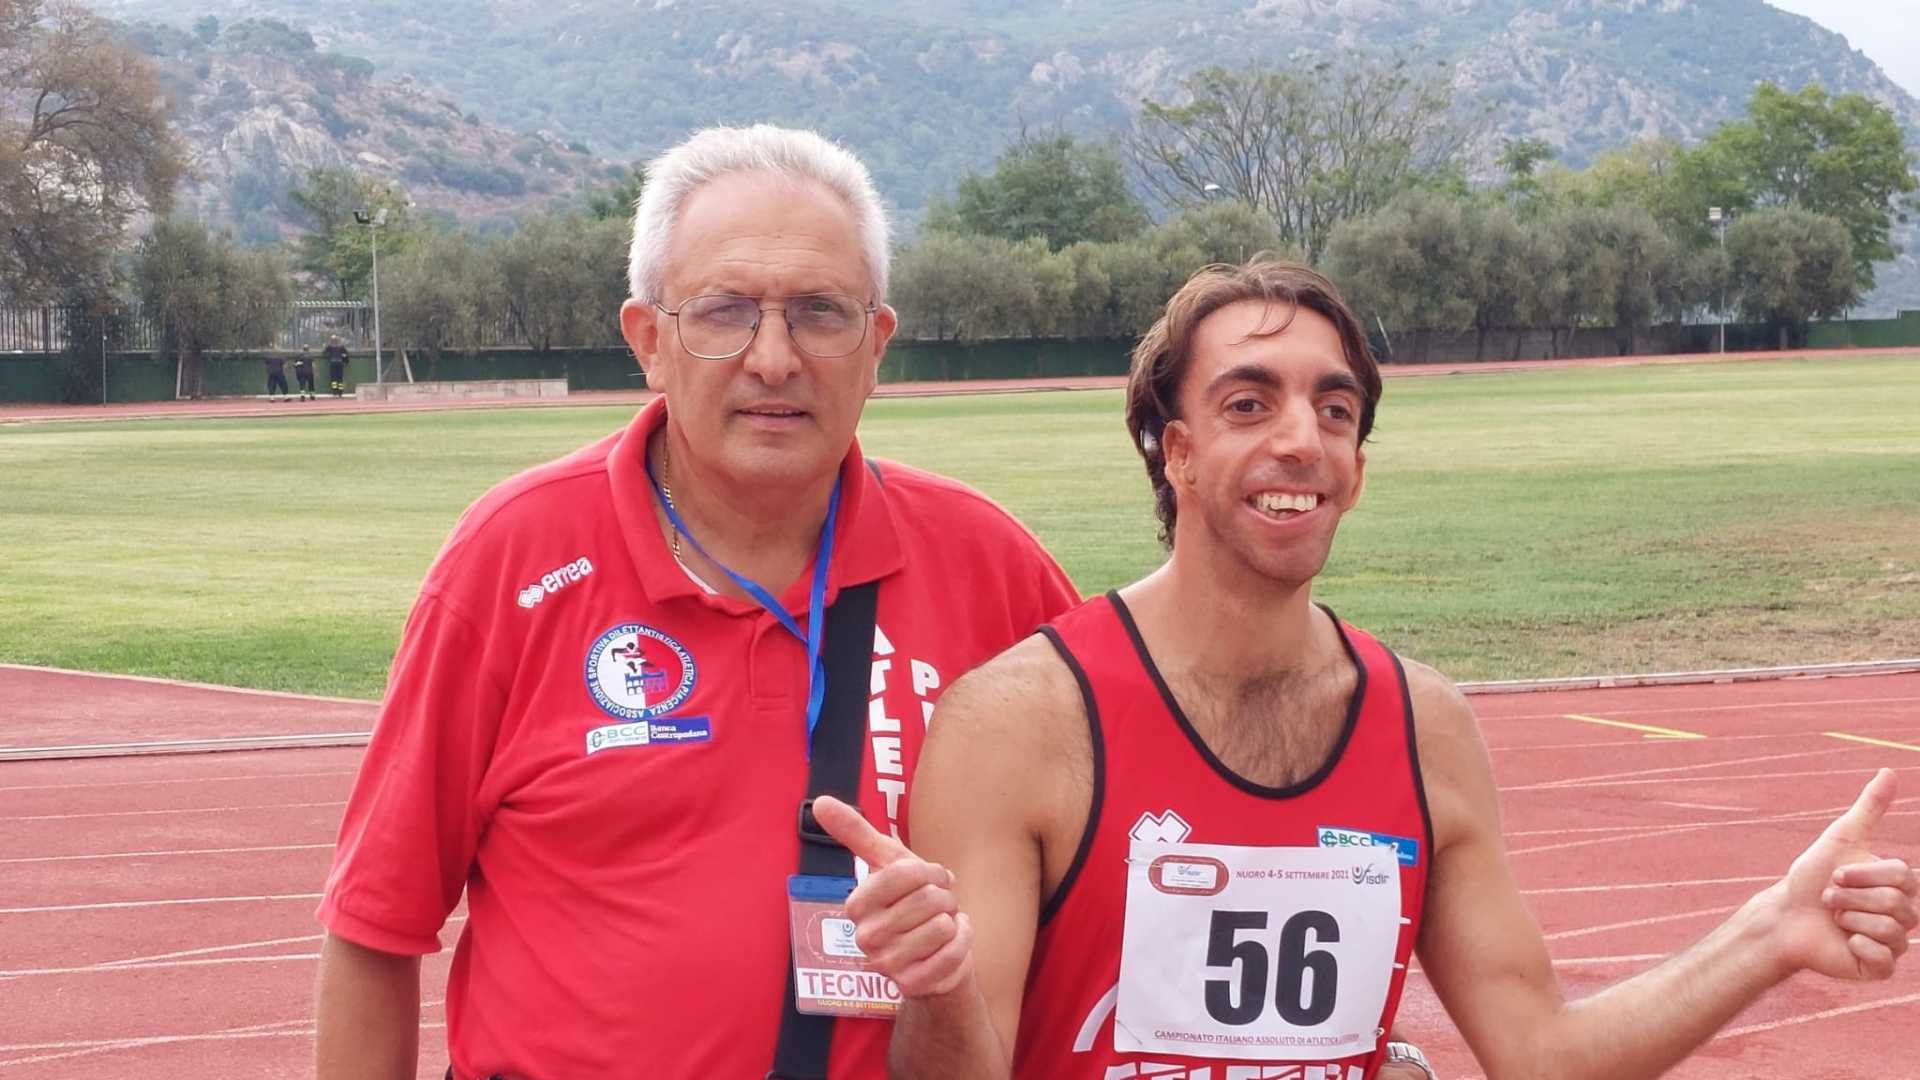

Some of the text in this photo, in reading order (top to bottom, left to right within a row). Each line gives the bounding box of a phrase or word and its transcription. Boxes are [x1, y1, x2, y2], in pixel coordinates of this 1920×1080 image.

[541, 556, 592, 593] errea
[588, 625, 695, 718] ASSOCIAZIONE SPORTIVA DILETTANTISTICA ATLETICA PIACENZA
[607, 726, 646, 739] BCC
[1338, 833, 1370, 847] BCC
[1236, 869, 1349, 880] NUORO 4-5 SETTEMBRE 2021
[1204, 909, 1340, 1027] 56
[1155, 1030, 1214, 1042] CAMPIONATO
[1216, 1035, 1254, 1045] ITALIANO
[1256, 1036, 1295, 1046] ASSOLUTO
[1306, 1036, 1339, 1046] ATLETICA
